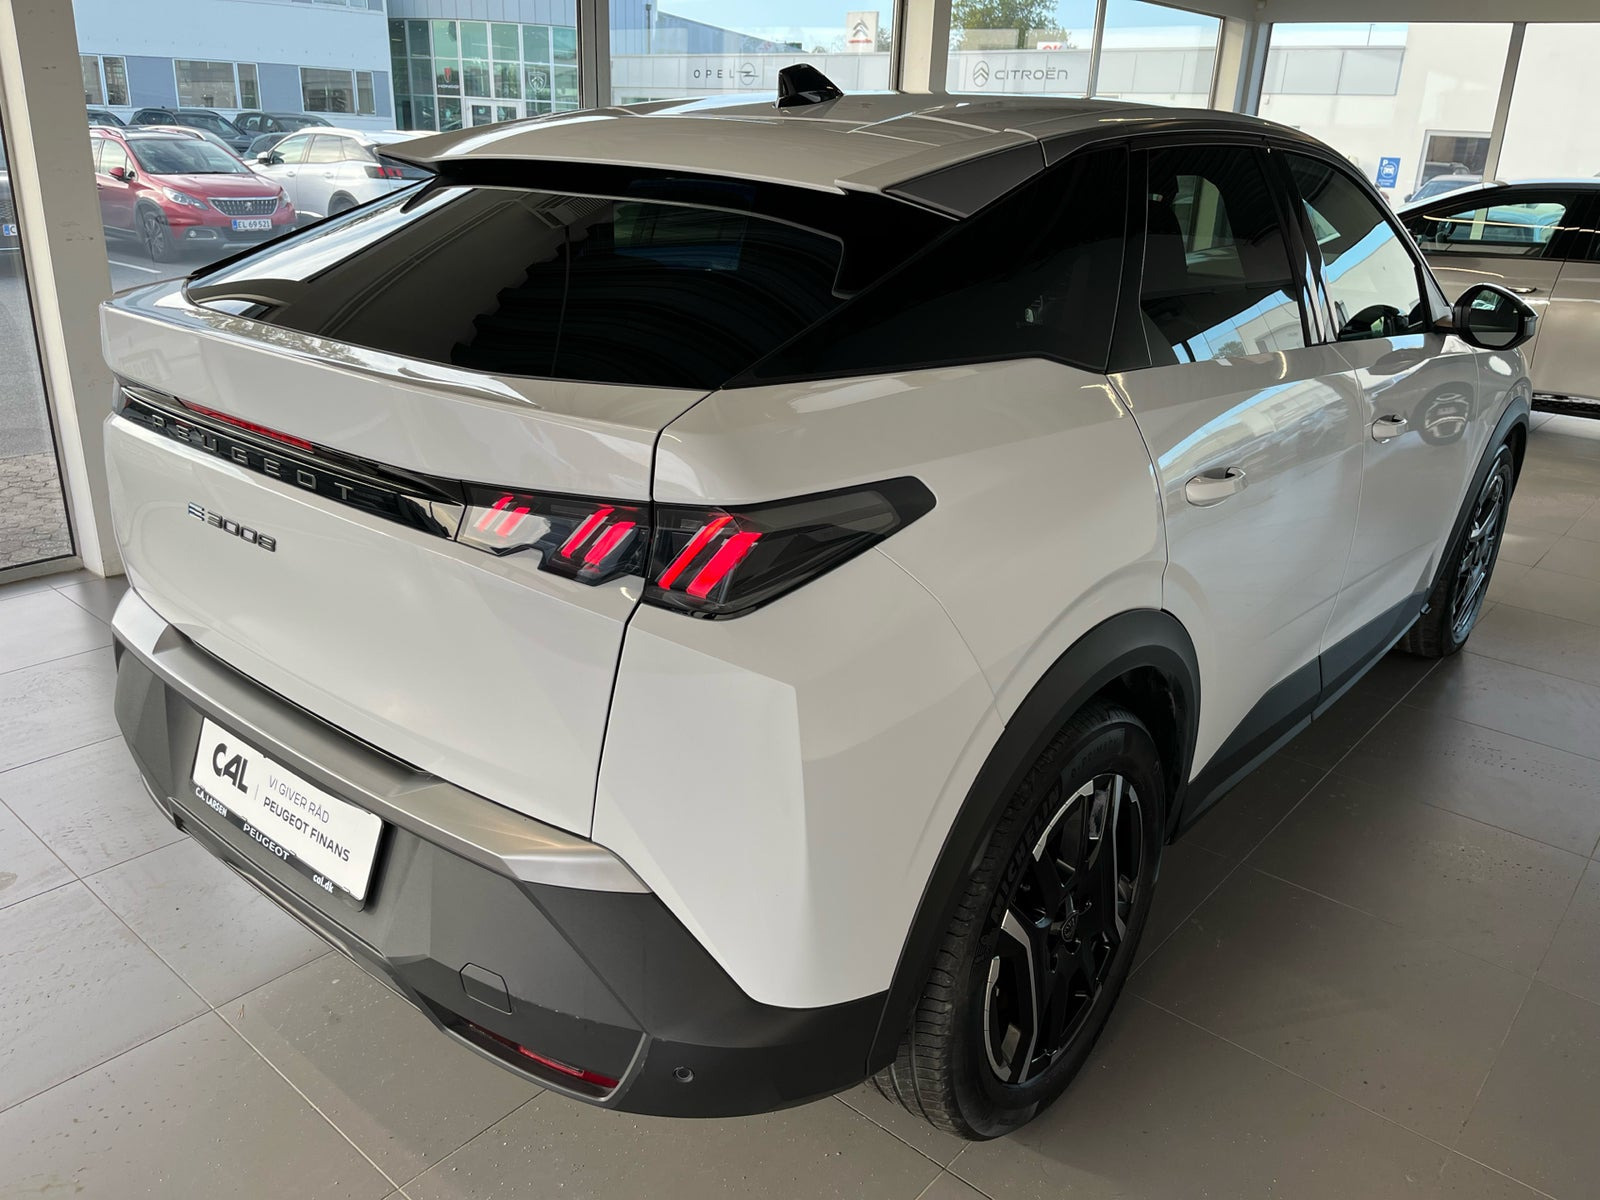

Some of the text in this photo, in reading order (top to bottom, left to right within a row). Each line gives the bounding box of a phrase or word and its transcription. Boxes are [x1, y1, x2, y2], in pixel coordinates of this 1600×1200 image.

[693, 69, 735, 79] OPEL
[994, 66, 1069, 80] CITROËN
[151, 414, 355, 501] PEUGEOT
[212, 742, 249, 795] CAL
[205, 795, 228, 817] LARSEN
[268, 774, 330, 824] VI GIVER RÅD
[243, 822, 290, 860] PEUGEOT
[263, 796, 351, 862] PEUGEOT FINANS
[312, 873, 334, 894] cal.dk
